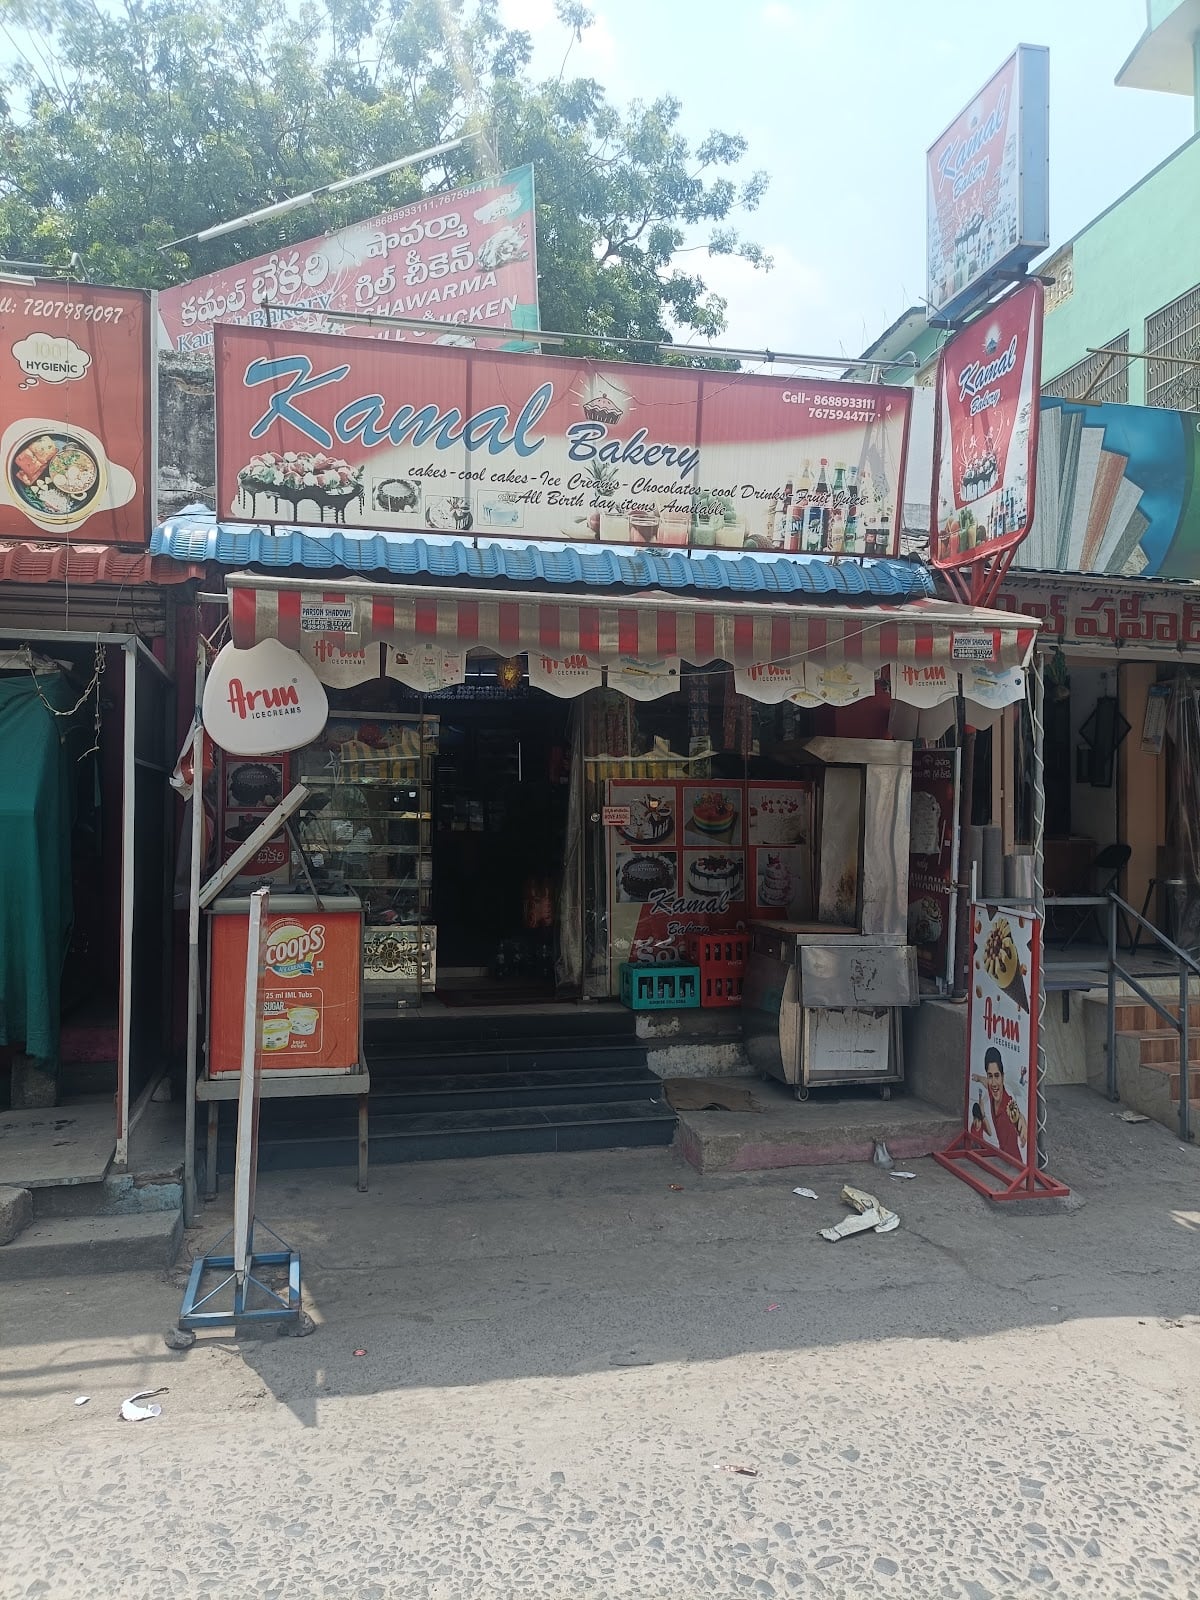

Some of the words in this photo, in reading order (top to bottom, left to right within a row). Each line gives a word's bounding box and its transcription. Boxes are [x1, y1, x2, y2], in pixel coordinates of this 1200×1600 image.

[938, 84, 1007, 192] Kamal
[23, 298, 124, 324] 7207989097
[181, 278, 247, 328] కమల్
[26, 360, 78, 373] HYGIENIC
[959, 334, 1018, 402] Kamal
[243, 354, 556, 459] Kamal
[808, 407, 876, 423] 7675944717
[813, 394, 876, 410] 8688933111
[970, 388, 1000, 416] Bakery
[566, 421, 702, 479] Bakery
[515, 488, 541, 505] All
[547, 491, 584, 508] Birth
[589, 493, 616, 513] day
[620, 497, 656, 513] items
[660, 498, 726, 517] Available
[227, 678, 299, 720] Arun
[252, 706, 302, 720] ICECREAMS
[649, 888, 732, 915] Kamal
[298, 990, 313, 998] Tubs
[983, 996, 1020, 1043] Arun
